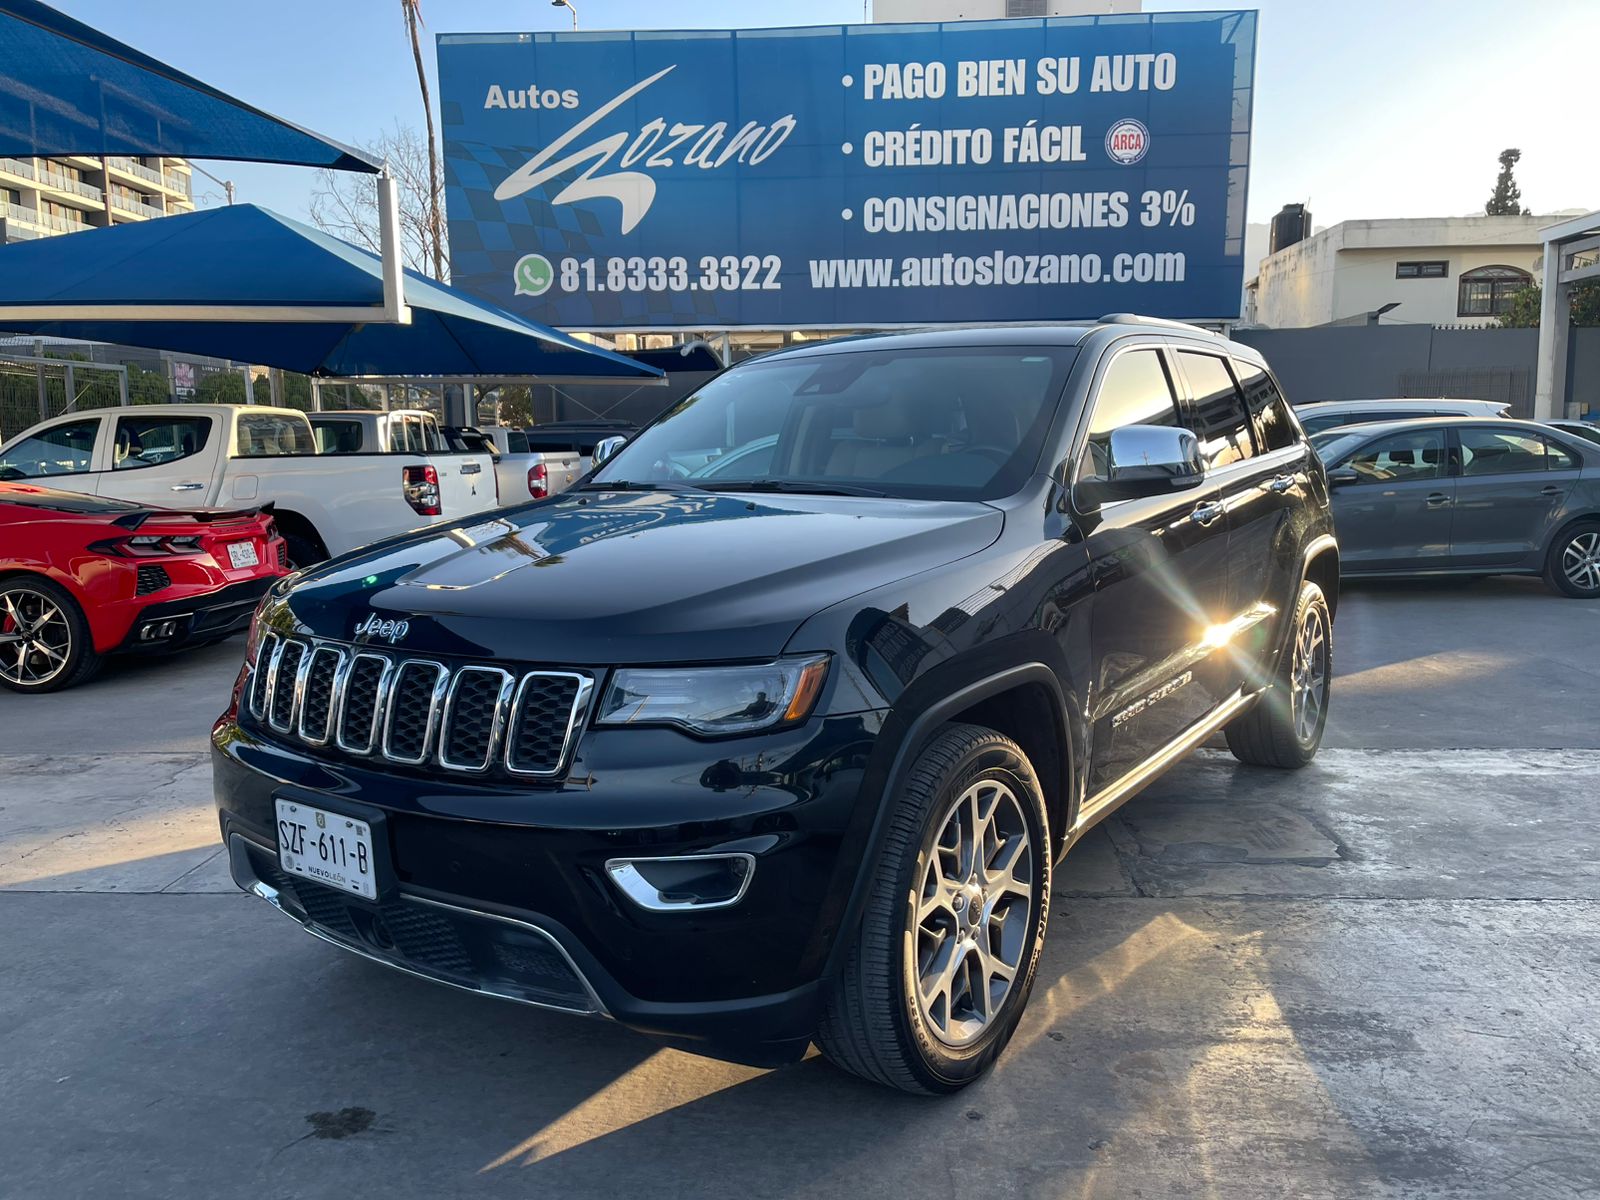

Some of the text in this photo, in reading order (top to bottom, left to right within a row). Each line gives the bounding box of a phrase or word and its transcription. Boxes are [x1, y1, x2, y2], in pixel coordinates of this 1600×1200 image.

[865, 53, 1177, 100] PAGO BIEN SU AUTO
[484, 85, 579, 109] Autos
[493, 64, 797, 235] Lozano
[864, 119, 1087, 167] CRÉDITO FÁCIL
[1113, 134, 1142, 150] ARCA
[864, 189, 1196, 233] CONSIGNACIONES 3%
[560, 255, 782, 292] 81.8333.3322
[809, 251, 1186, 288] www.autoslozano.com
[354, 612, 409, 644] Jeep
[279, 819, 368, 875] SZF-611-B
